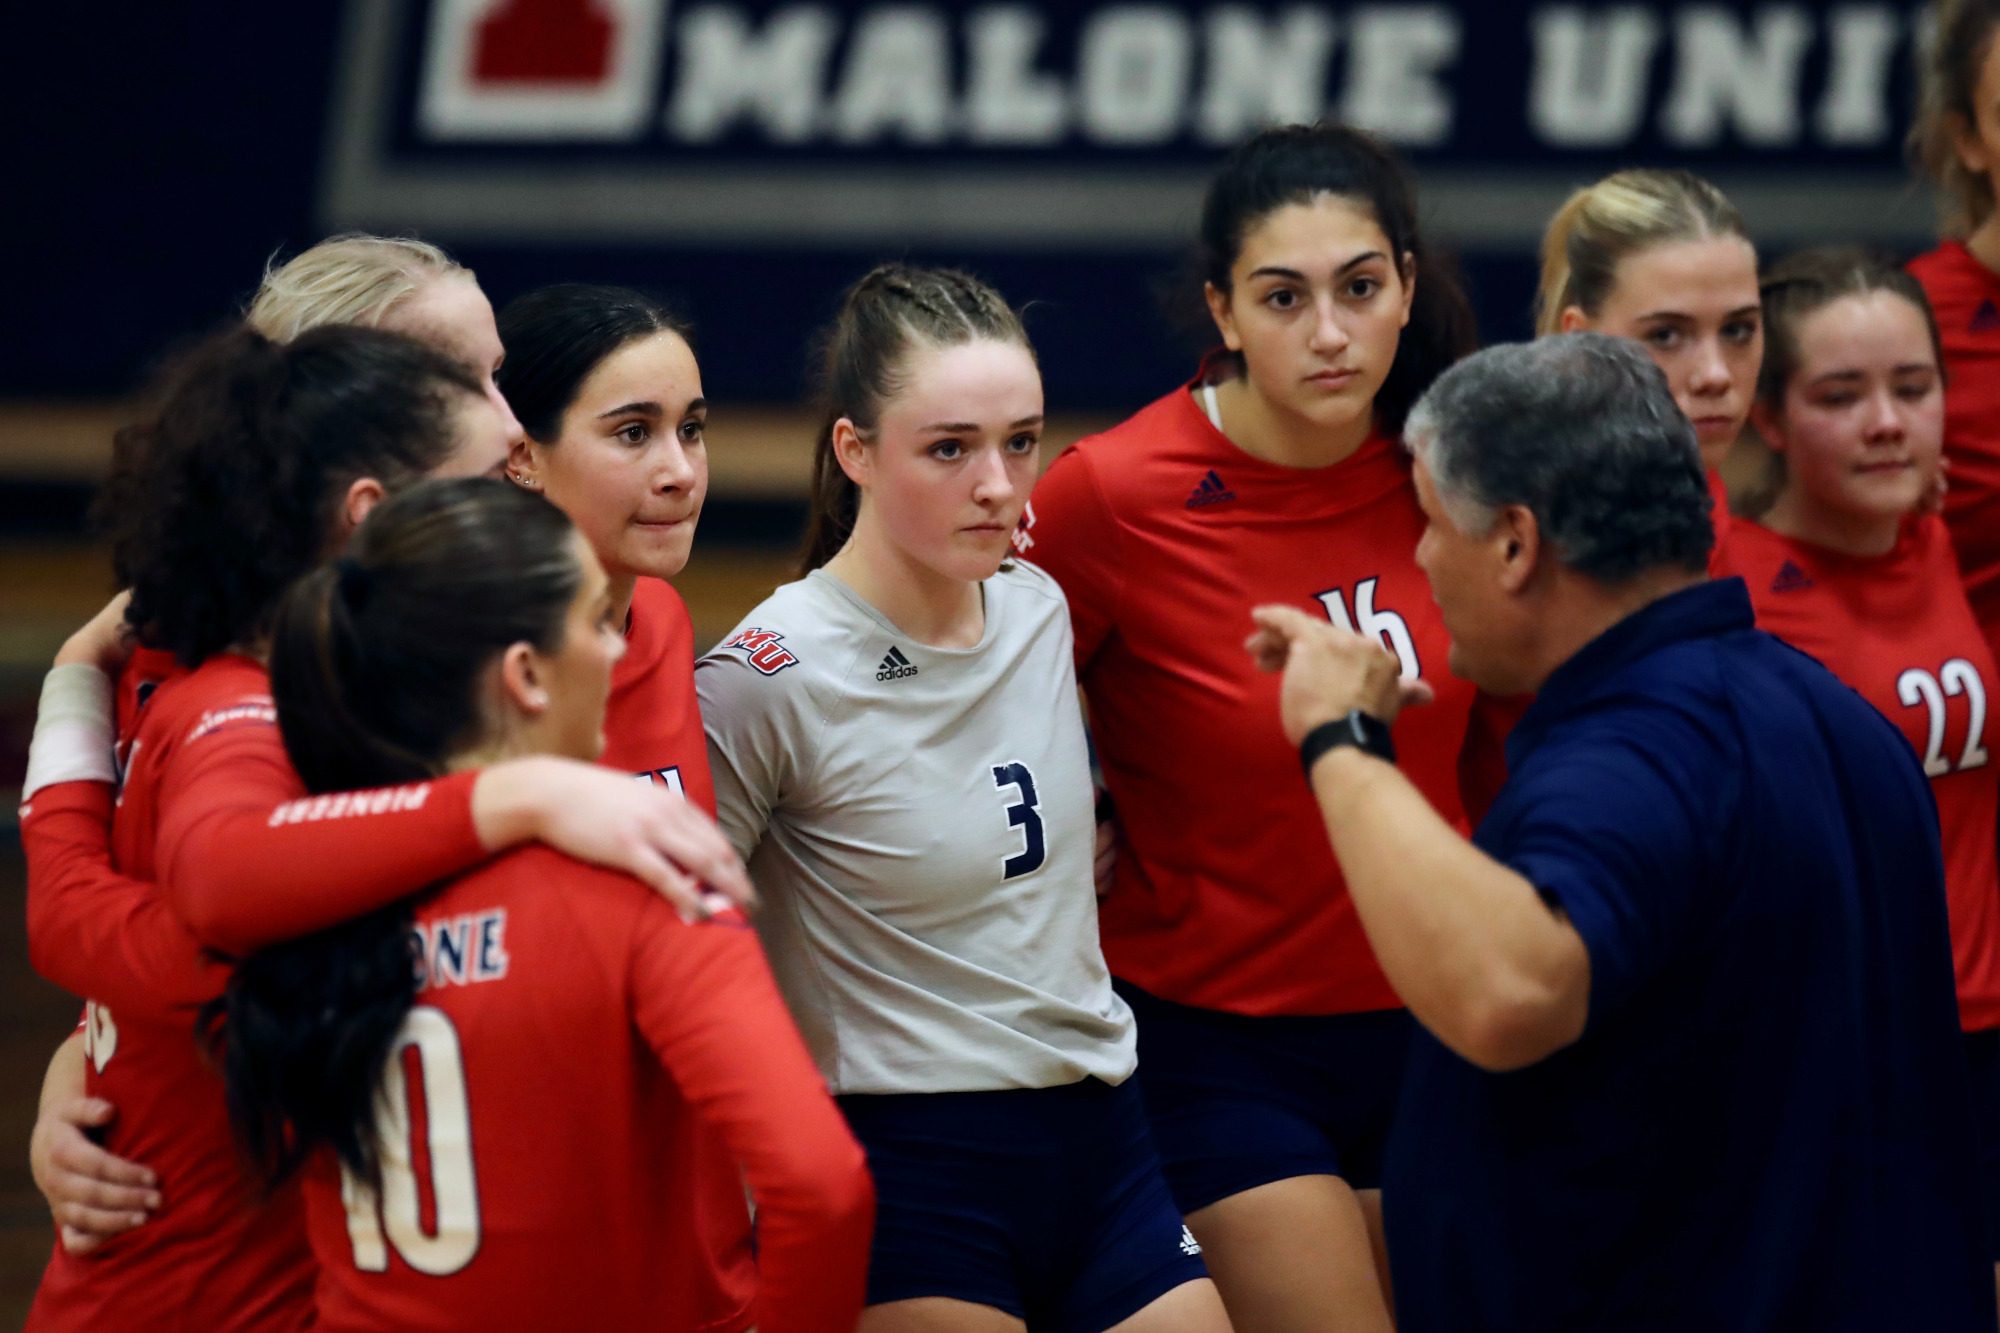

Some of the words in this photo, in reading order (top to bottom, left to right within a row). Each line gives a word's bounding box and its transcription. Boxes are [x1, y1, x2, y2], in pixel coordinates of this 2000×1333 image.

[666, 5, 1459, 144] MALONE
[1527, 5, 1938, 143] UNI
[722, 627, 800, 677] MU
[876, 665, 918, 681] adidas
[1897, 657, 1989, 778] 22
[267, 782, 432, 828] PIONEERS
[991, 759, 1048, 884] 3
